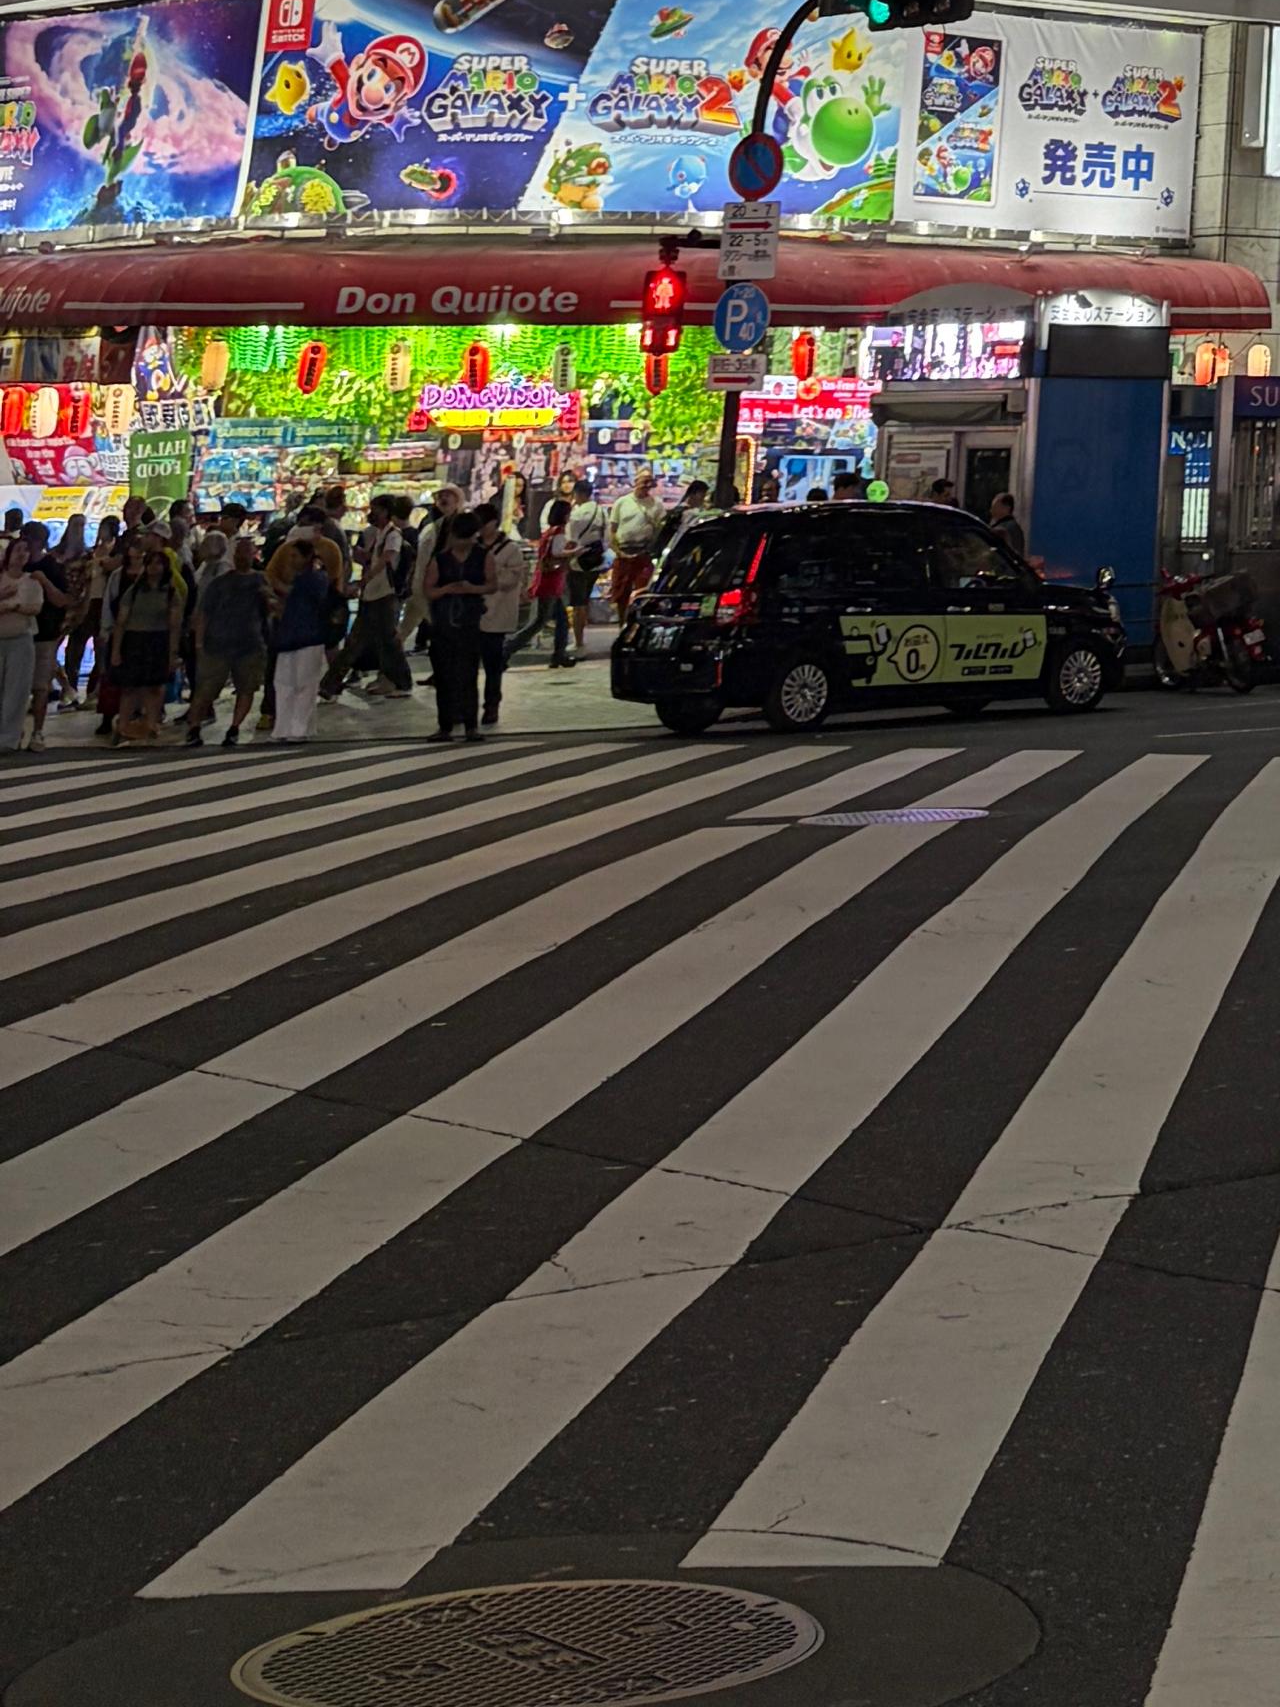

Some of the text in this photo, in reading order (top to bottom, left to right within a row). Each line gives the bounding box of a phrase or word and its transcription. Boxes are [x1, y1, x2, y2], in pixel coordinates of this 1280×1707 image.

[455, 54, 529, 72] SUPER
[632, 56, 707, 76] SUPER
[1035, 57, 1079, 73] SUPER
[1123, 65, 1165, 81] SUPER
[448, 70, 540, 93] MARIO
[610, 73, 697, 95] MARIO
[1031, 68, 1082, 89] MARIO
[1115, 75, 1159, 94] MARIO
[421, 89, 553, 131] GALAXY
[586, 75, 742, 134] GALAXY 2
[1018, 83, 1089, 115] GALAXY
[1101, 81, 1184, 123] GALAXY 2
[1042, 139, 1156, 192] 発売中
[0, 287, 51, 316] uijote
[336, 286, 578, 316] Don Quijote
[724, 299, 749, 341] P
